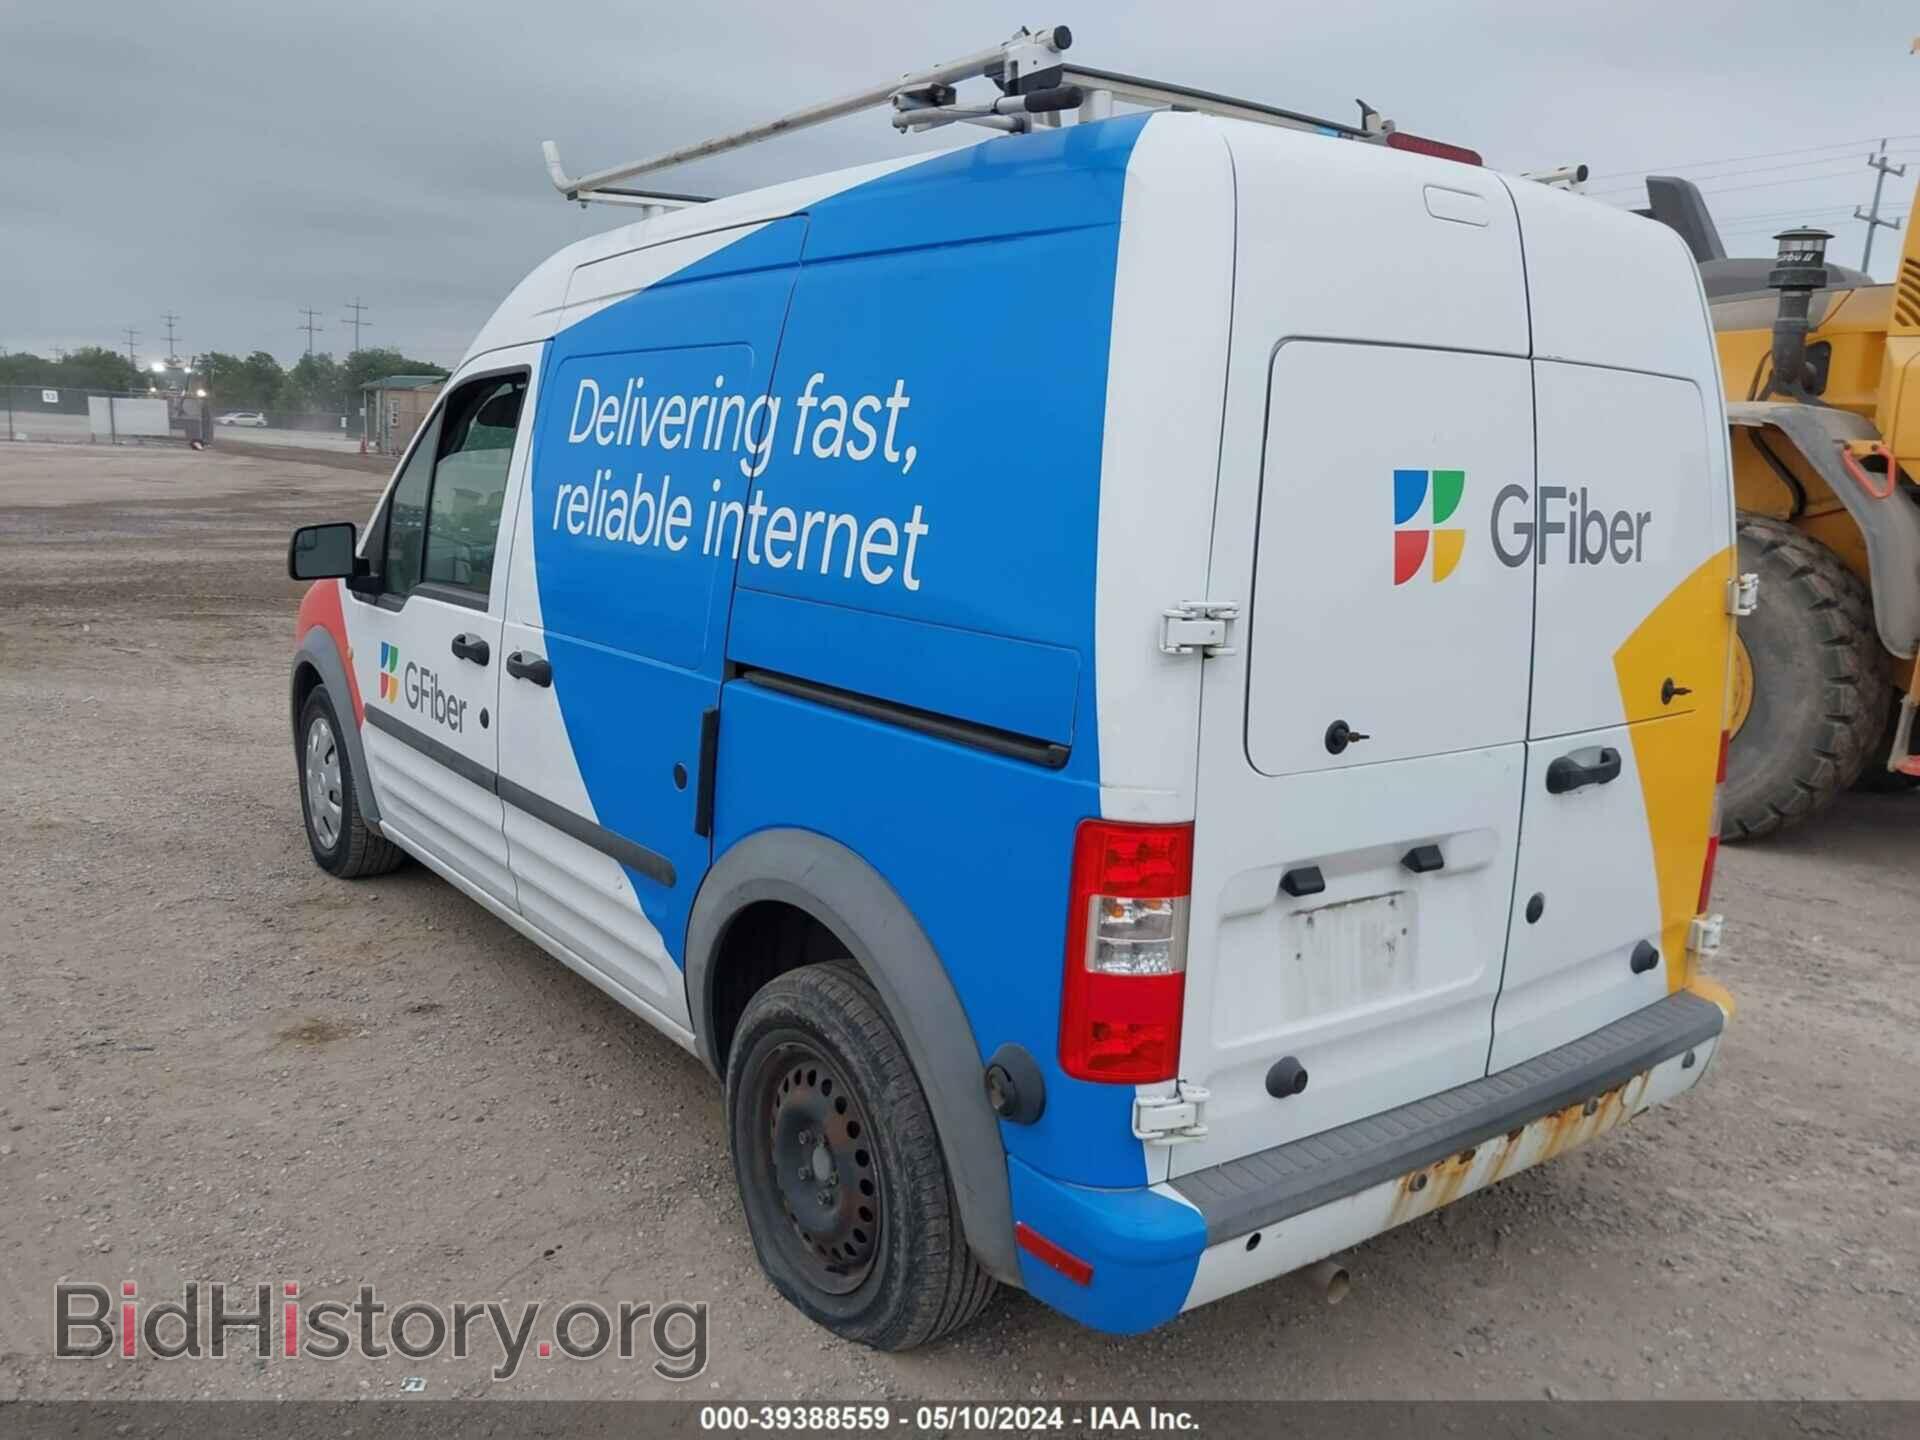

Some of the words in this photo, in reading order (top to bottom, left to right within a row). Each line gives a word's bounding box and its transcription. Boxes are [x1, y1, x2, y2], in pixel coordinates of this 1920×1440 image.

[568, 374, 782, 478] Delivering
[792, 372, 917, 475] fast,
[552, 469, 692, 551] reliable
[702, 478, 929, 591] internet
[1490, 483, 1652, 568] GFiber
[404, 661, 467, 733] GFiber
